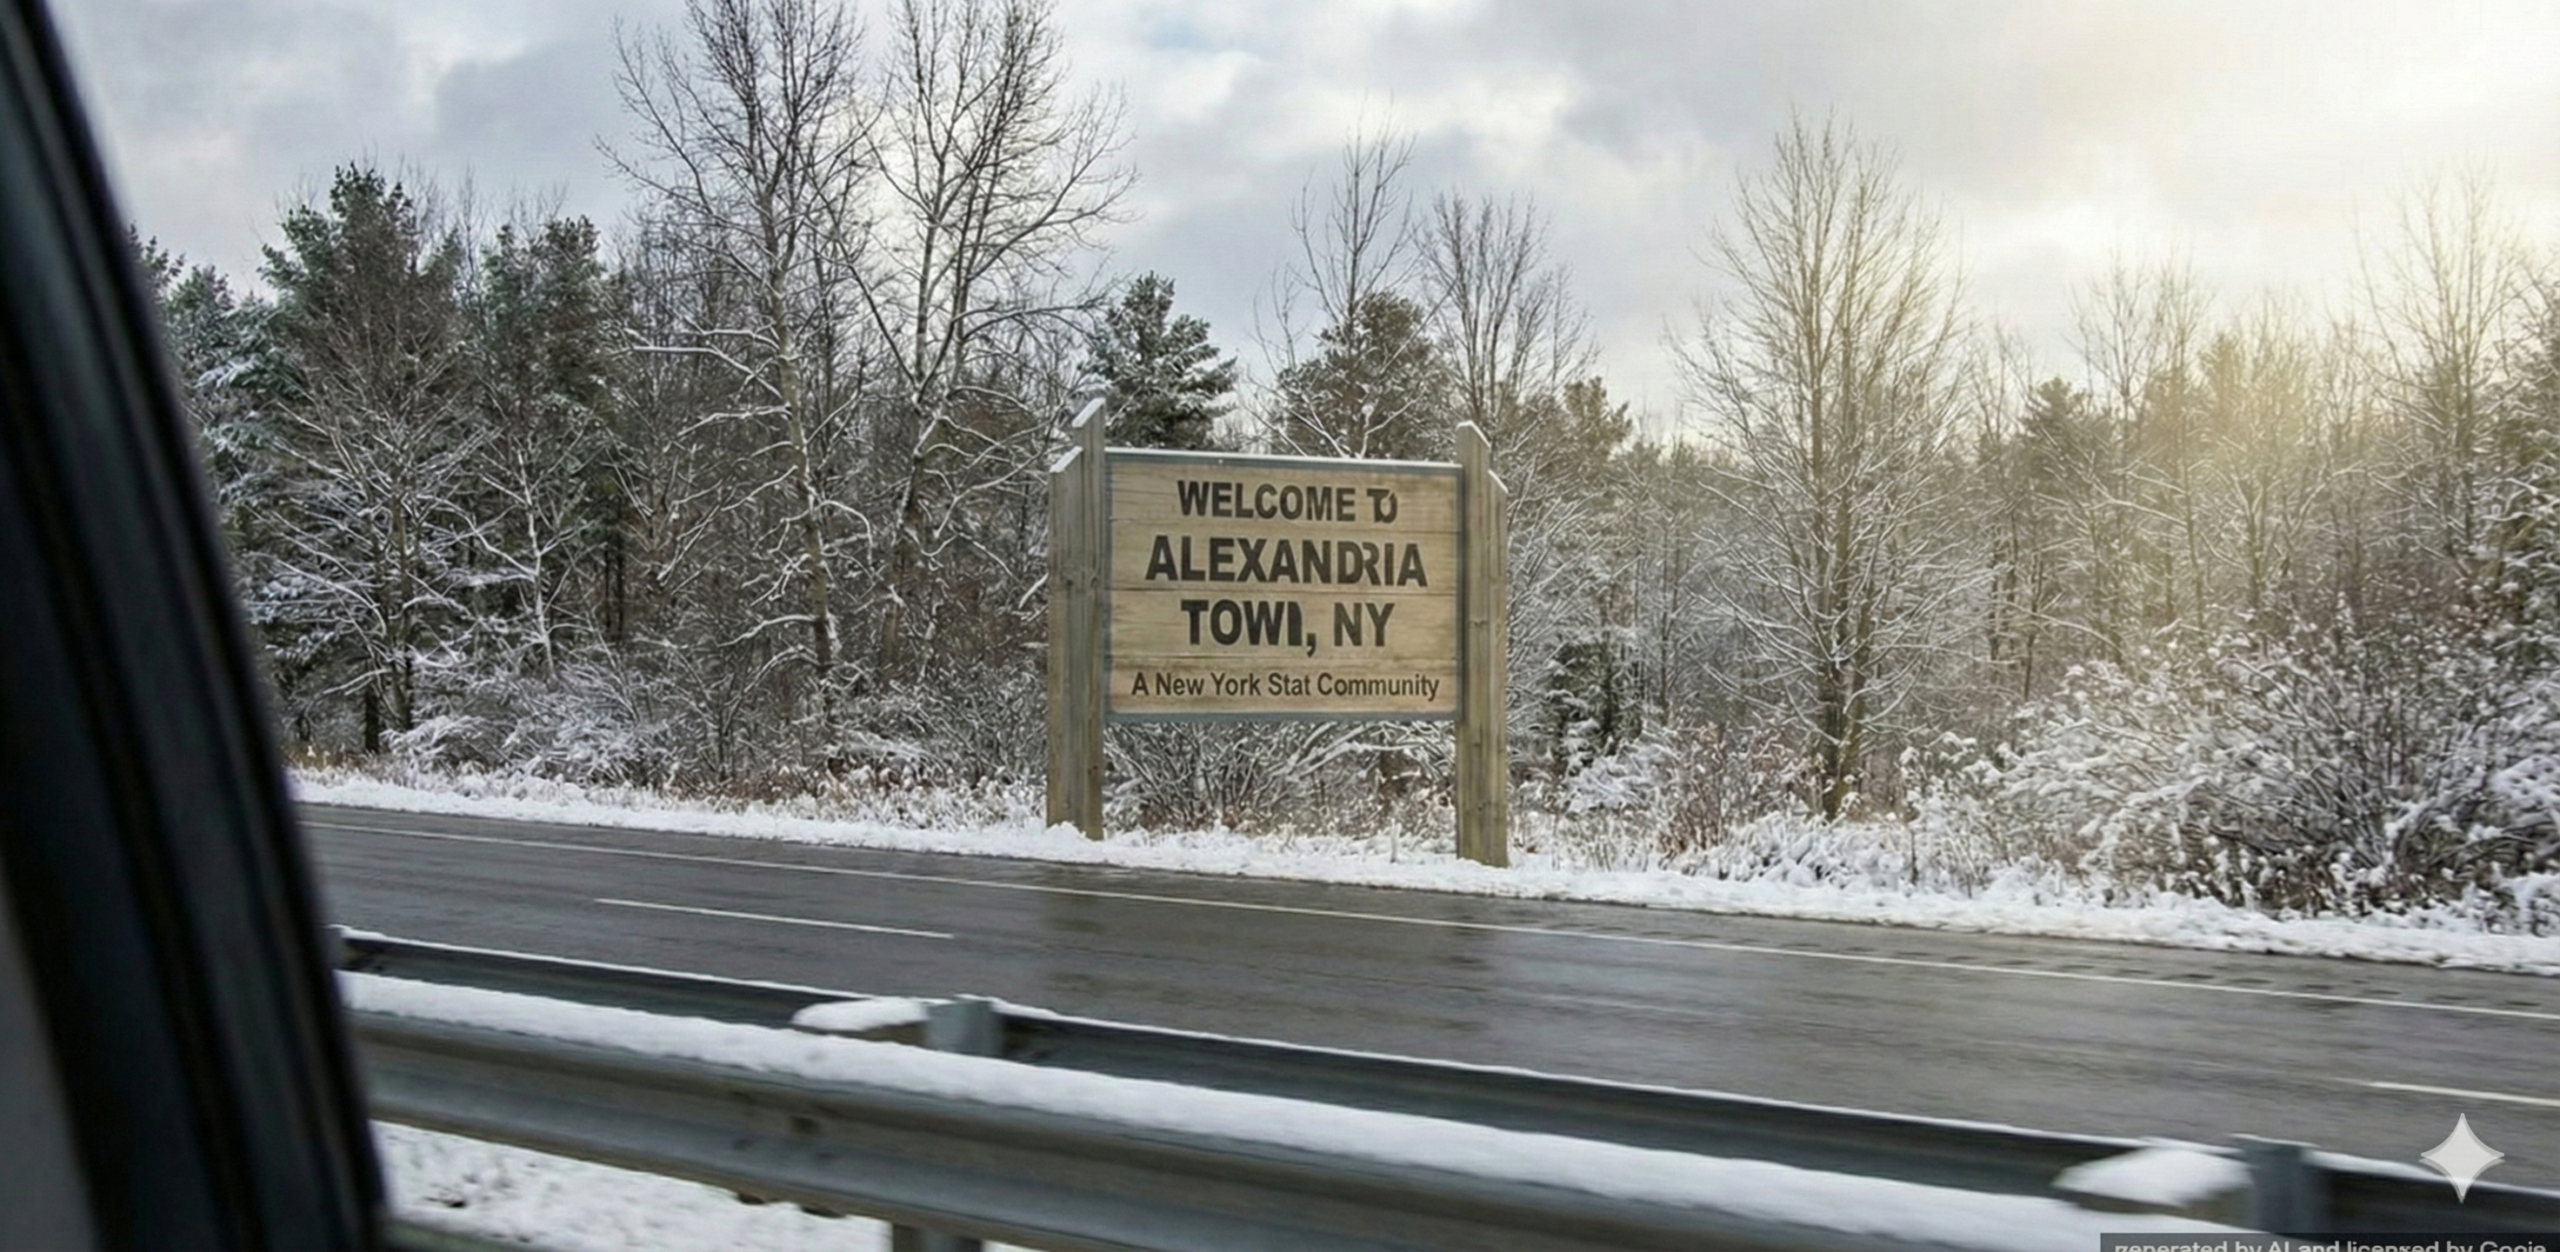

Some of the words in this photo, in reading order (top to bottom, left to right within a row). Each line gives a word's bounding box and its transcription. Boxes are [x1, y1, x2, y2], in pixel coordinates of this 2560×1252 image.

[1176, 480, 1356, 522] WELCOME
[1366, 488, 1399, 524] TO
[1145, 535, 1429, 588] ALEXANDRIA
[1333, 602, 1396, 647] NY
[1131, 673, 1150, 696] A
[1155, 673, 1206, 696] New
[1210, 673, 1262, 697] York
[1267, 673, 1312, 697] Stat
[1316, 673, 1440, 702] Community
